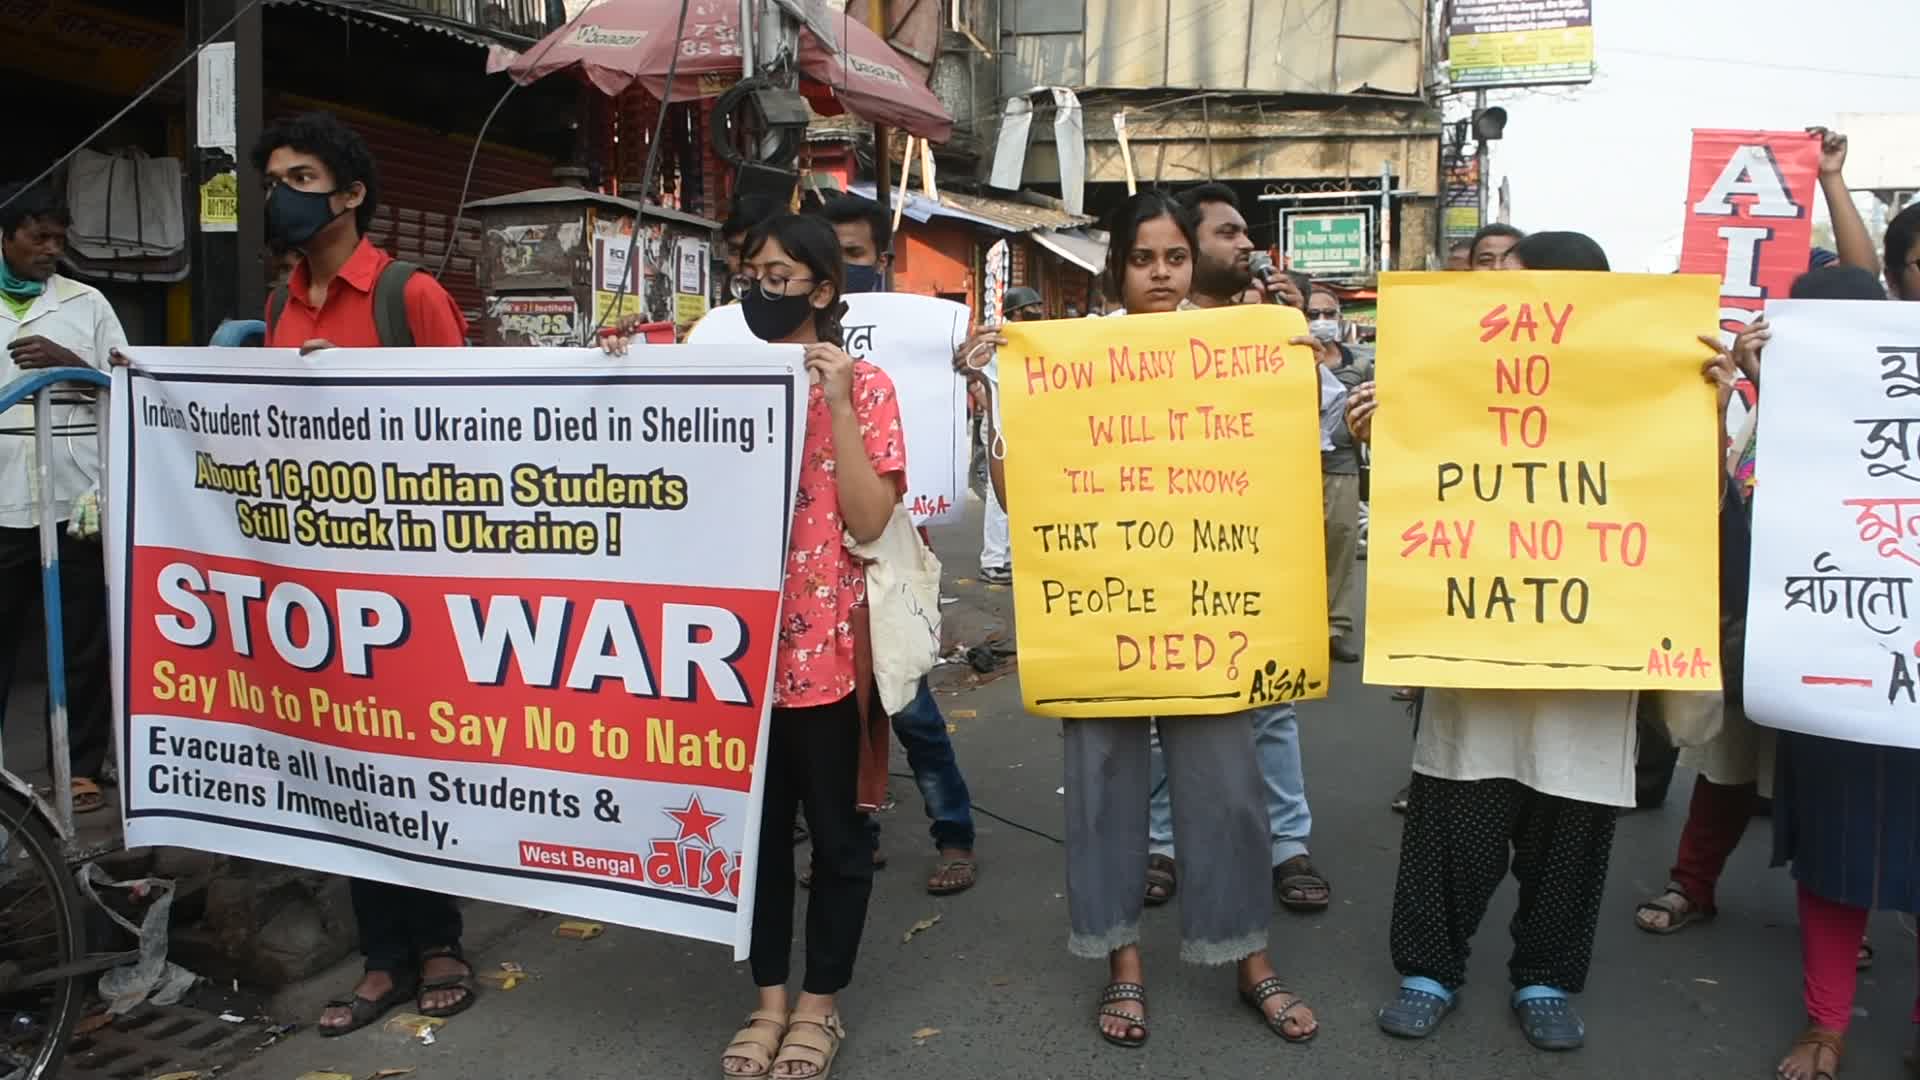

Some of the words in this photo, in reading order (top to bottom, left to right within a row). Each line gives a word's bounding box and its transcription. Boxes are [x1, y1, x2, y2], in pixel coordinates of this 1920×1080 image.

[1479, 302, 1574, 344] SAY
[1025, 356, 1093, 396] HOW
[1108, 346, 1176, 384] MANY
[1189, 338, 1285, 380] DEATHS
[1496, 355, 1550, 396] NO
[143, 396, 187, 431] Indian
[188, 401, 261, 437] Student
[267, 404, 371, 441] Stranded
[380, 407, 403, 441] in
[415, 406, 522, 442] Ukraine
[533, 407, 597, 442] Died
[608, 407, 632, 442] in
[642, 406, 754, 452] Shelling
[1088, 415, 1154, 447] WILL
[1168, 408, 1188, 441] IT
[1196, 405, 1255, 440] TAKE
[1488, 405, 1548, 448] TO
[195, 452, 262, 496] About
[267, 458, 376, 506] 16,000
[382, 462, 503, 506] Indian
[511, 463, 687, 510] Students
[1120, 466, 1154, 492] HE
[1168, 466, 1249, 496] KNOWS
[1438, 461, 1608, 505] PUTIN
[236, 499, 290, 544] Still
[295, 502, 395, 550] Stuck
[397, 509, 436, 552] in
[443, 510, 598, 554] Ukraine
[1034, 521, 1098, 552] THAT
[1116, 520, 1174, 550] TOO
[1193, 519, 1260, 554] MANY
[1401, 519, 1475, 559] SAY
[1509, 519, 1563, 561] NO
[1587, 521, 1648, 567] TO
[1042, 577, 1156, 614] PEOPLE
[1191, 580, 1261, 617] HAVE
[1446, 576, 1590, 624] NATO
[154, 563, 411, 677] STOP
[444, 594, 754, 707] WAR
[152, 660, 216, 714] Say
[227, 669, 264, 714] No
[271, 685, 301, 723] to
[309, 687, 415, 741] Putin.
[430, 701, 507, 757] Say
[524, 706, 576, 755] No
[589, 719, 629, 760] to
[149, 726, 280, 771] Evacuate
[288, 750, 317, 781] all
[325, 756, 416, 799] Indian
[428, 771, 580, 819] Students
[593, 789, 622, 823] &
[149, 764, 266, 808] Citizens
[277, 780, 458, 850] Immediately.
[523, 846, 568, 867] West
[573, 850, 635, 875] Bengal
